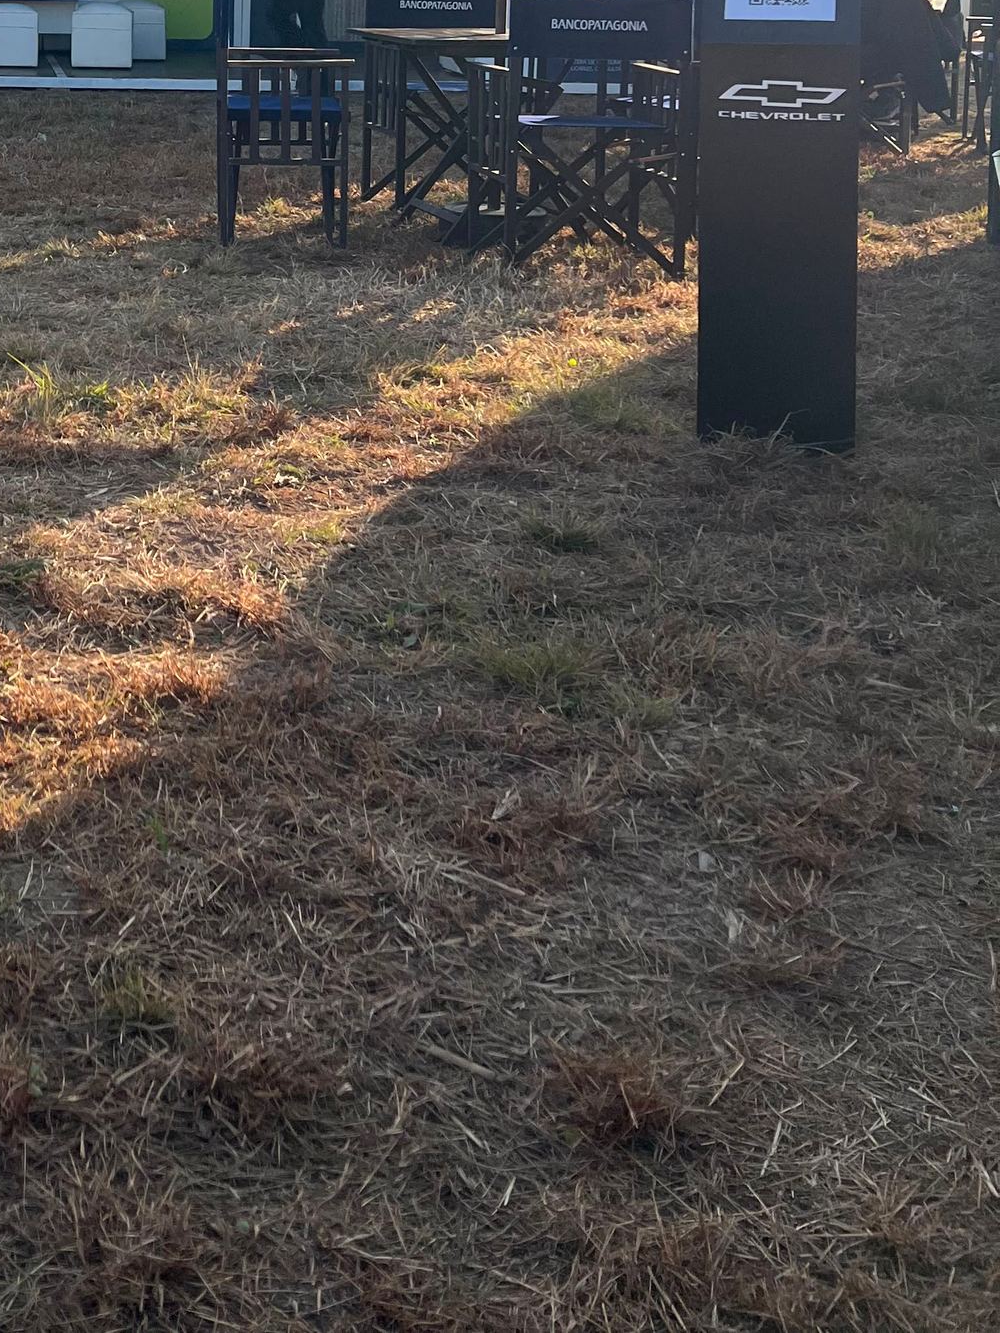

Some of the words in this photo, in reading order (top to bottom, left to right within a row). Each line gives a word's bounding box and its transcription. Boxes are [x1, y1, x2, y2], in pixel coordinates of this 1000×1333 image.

[399, 0, 473, 11] BANCOPATAGONIA
[551, 18, 648, 32] BANCOPATAGONIA
[718, 110, 846, 122] CHEVROLET
